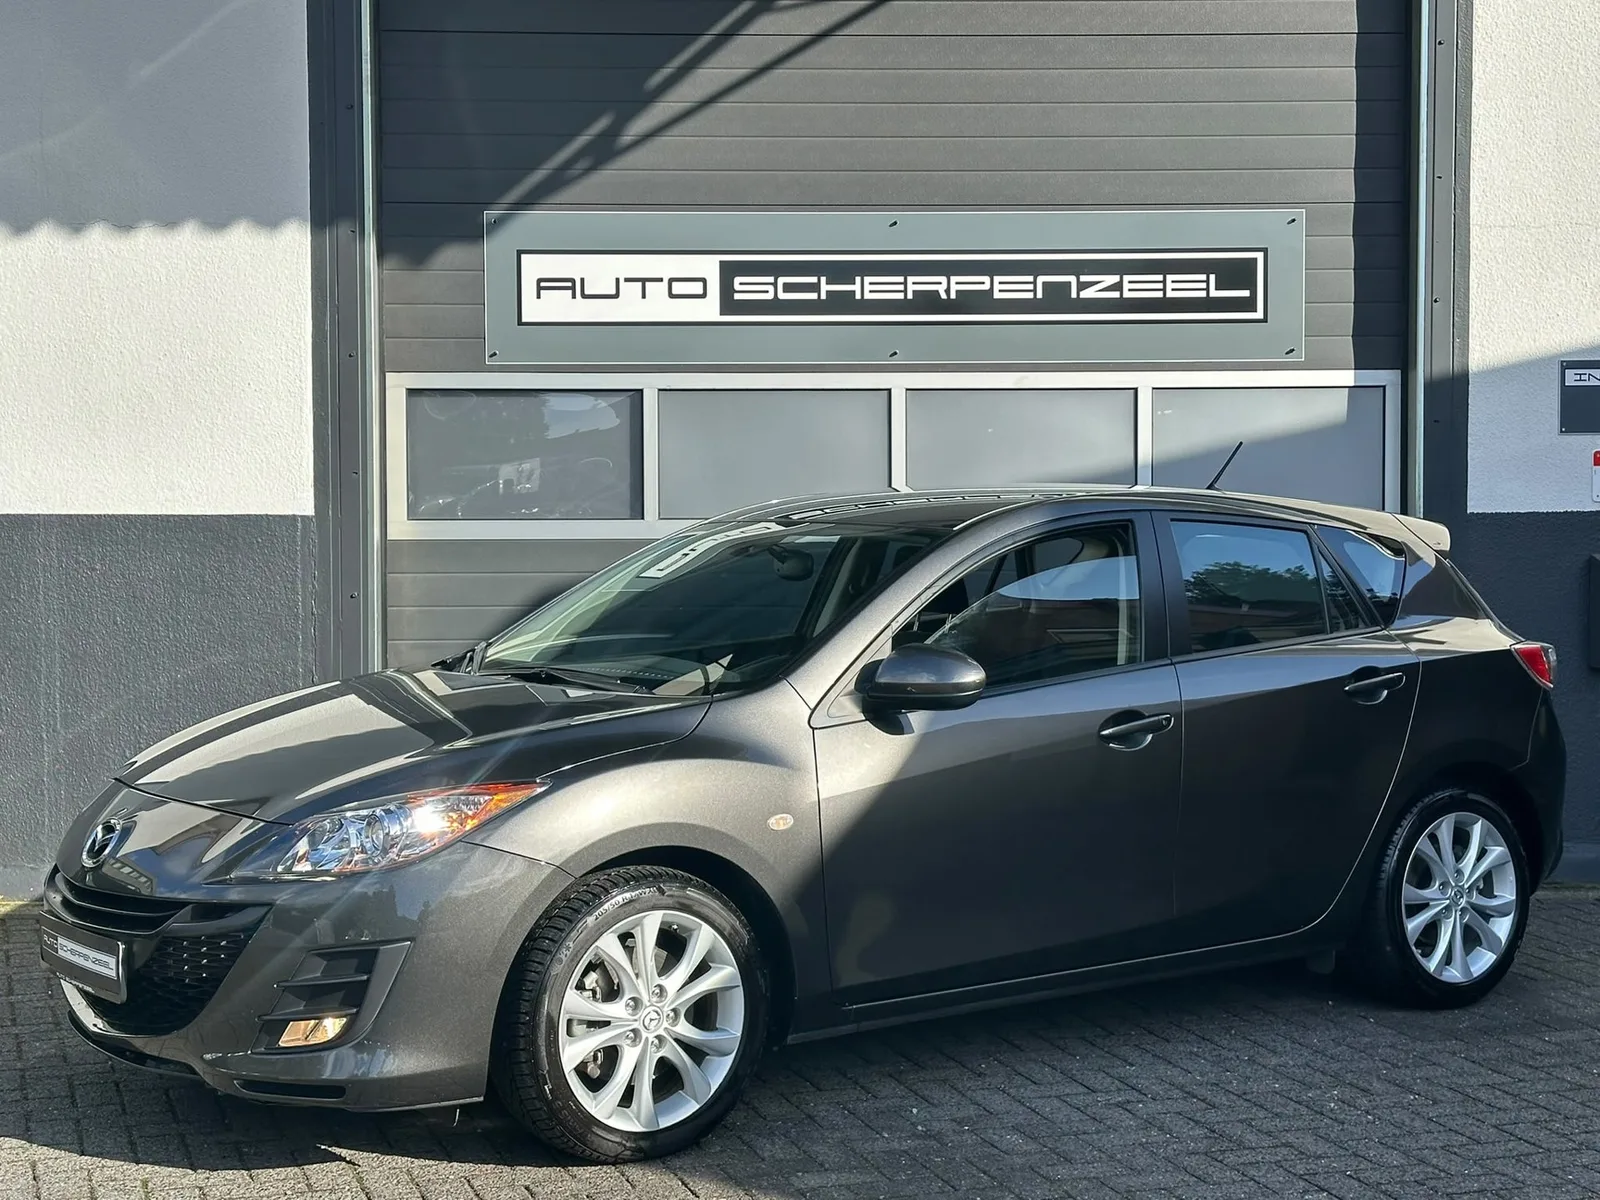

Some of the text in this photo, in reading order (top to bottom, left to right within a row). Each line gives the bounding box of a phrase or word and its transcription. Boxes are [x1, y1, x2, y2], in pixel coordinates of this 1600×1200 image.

[536, 273, 1251, 300] AUTO SCHERPENZEEL
[43, 934, 58, 948] AUTO
